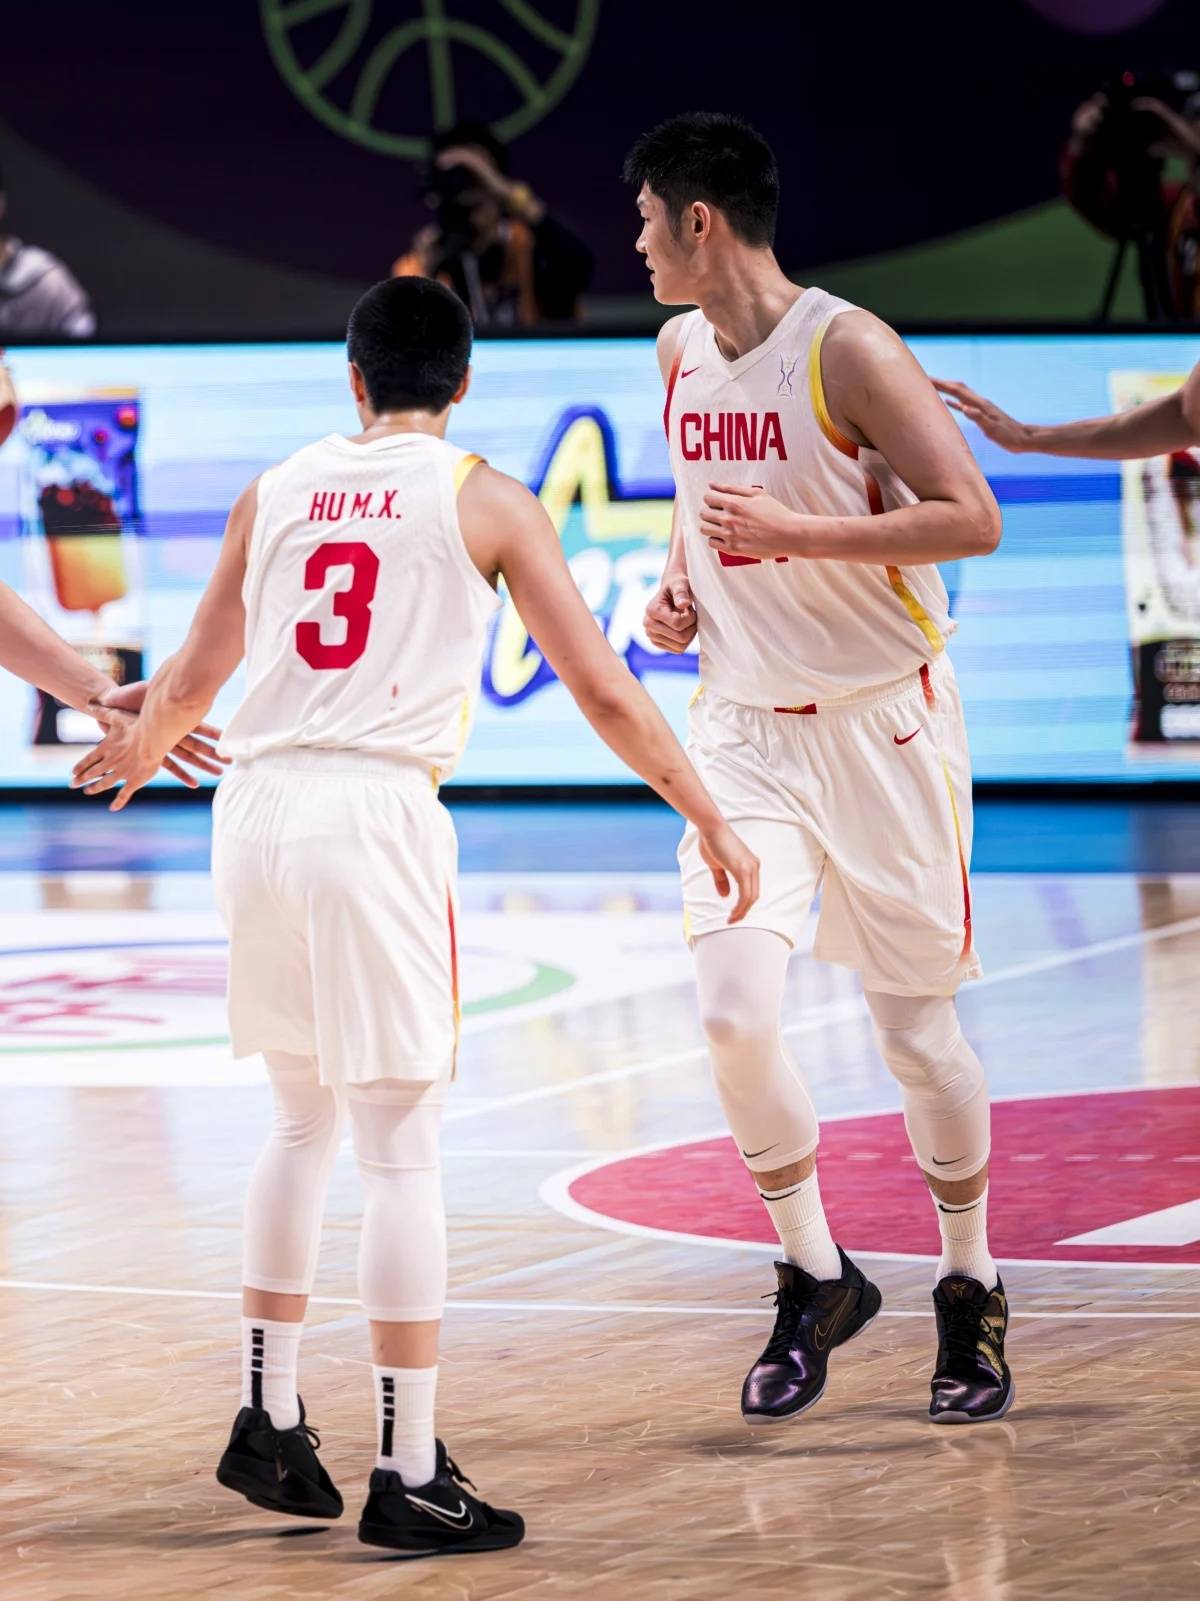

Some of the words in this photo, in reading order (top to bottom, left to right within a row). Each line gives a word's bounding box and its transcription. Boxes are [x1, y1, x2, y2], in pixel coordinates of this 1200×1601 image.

[680, 412, 788, 461] CHINA
[308, 492, 347, 522] HU
[350, 489, 403, 520] M.X.
[296, 542, 380, 670] 3
